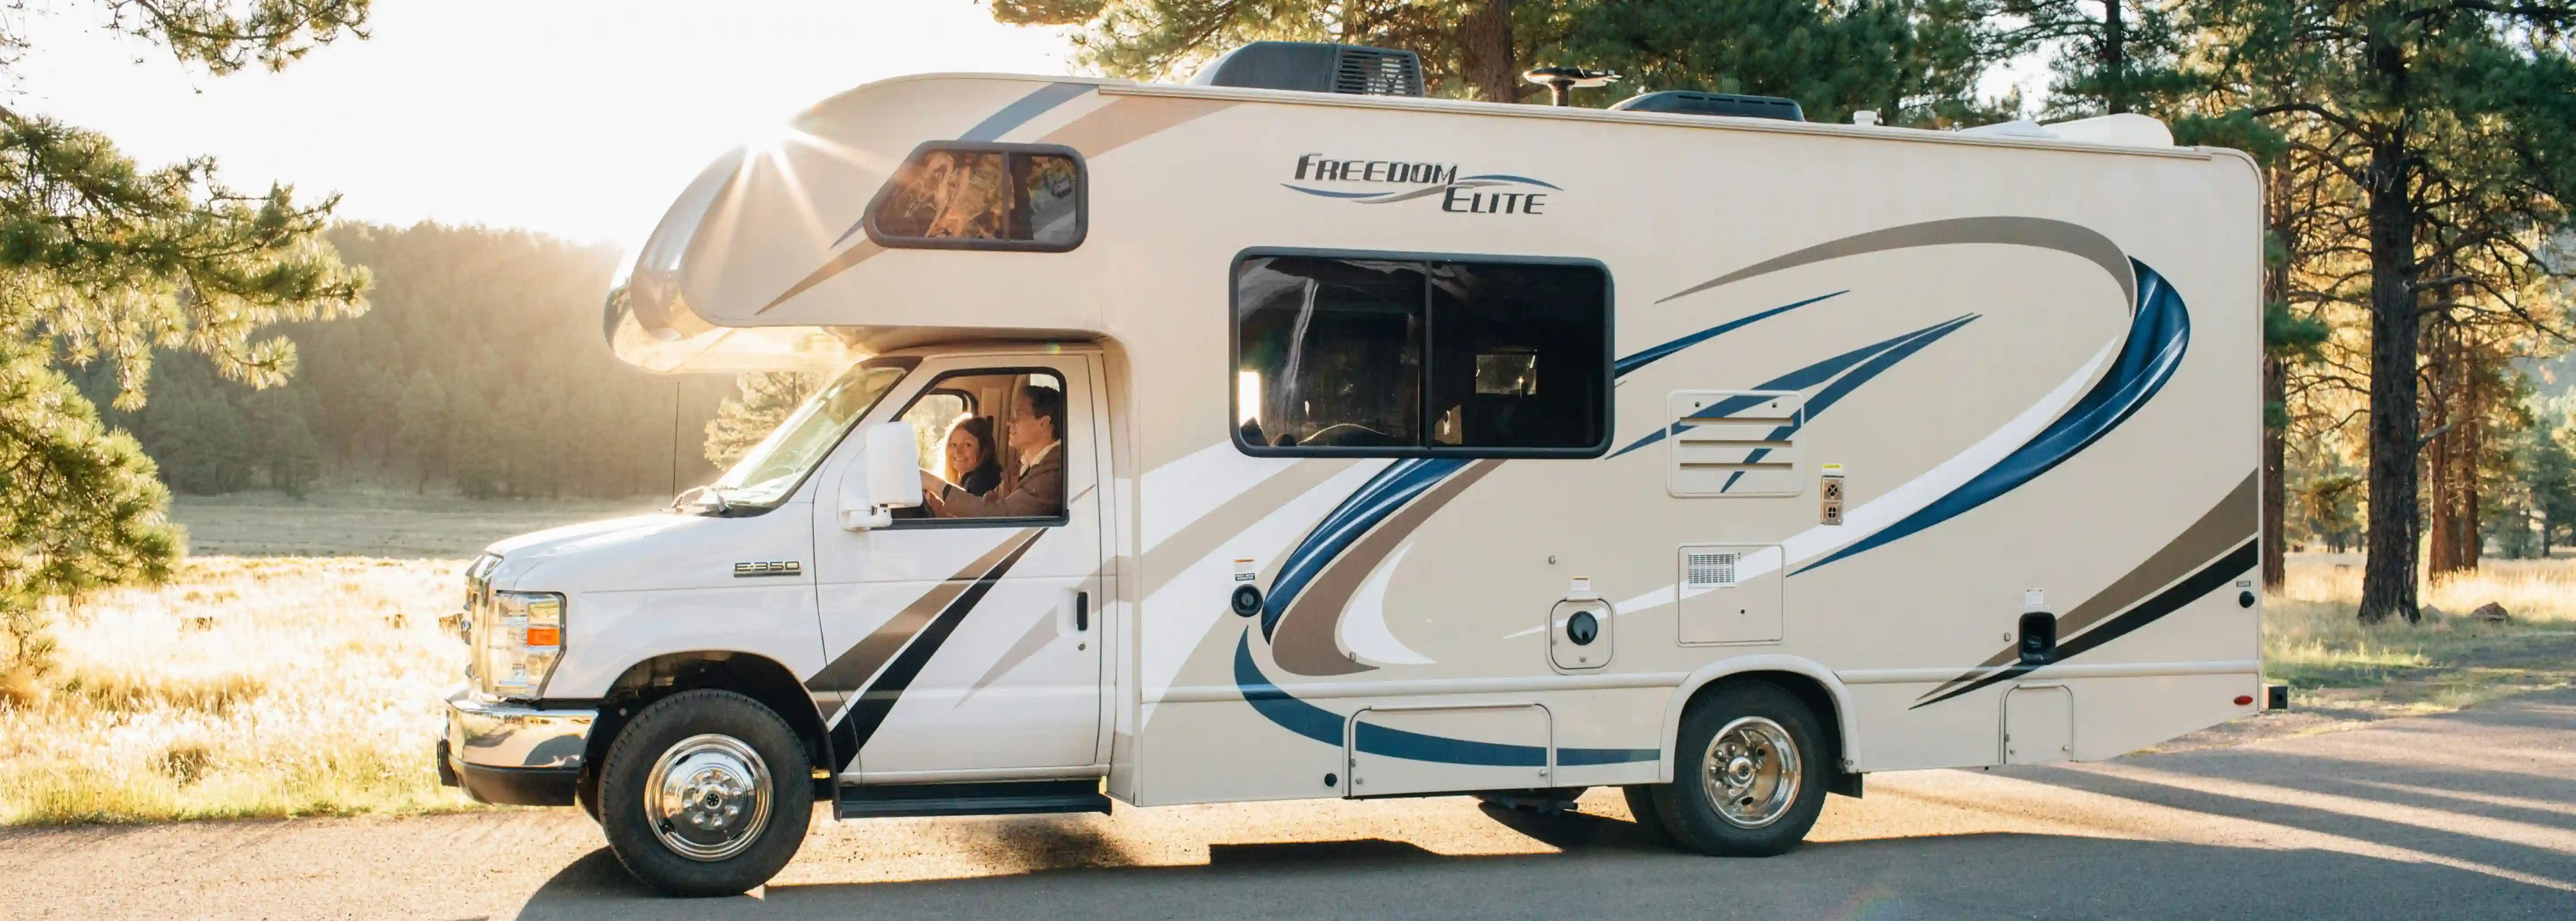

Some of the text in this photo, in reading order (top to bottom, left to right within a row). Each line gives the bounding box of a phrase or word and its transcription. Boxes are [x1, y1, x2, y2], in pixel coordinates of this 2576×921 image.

[1294, 153, 1458, 185] FREEDOM
[1442, 184, 1548, 214] ELITE
[734, 561, 800, 571] E-350
